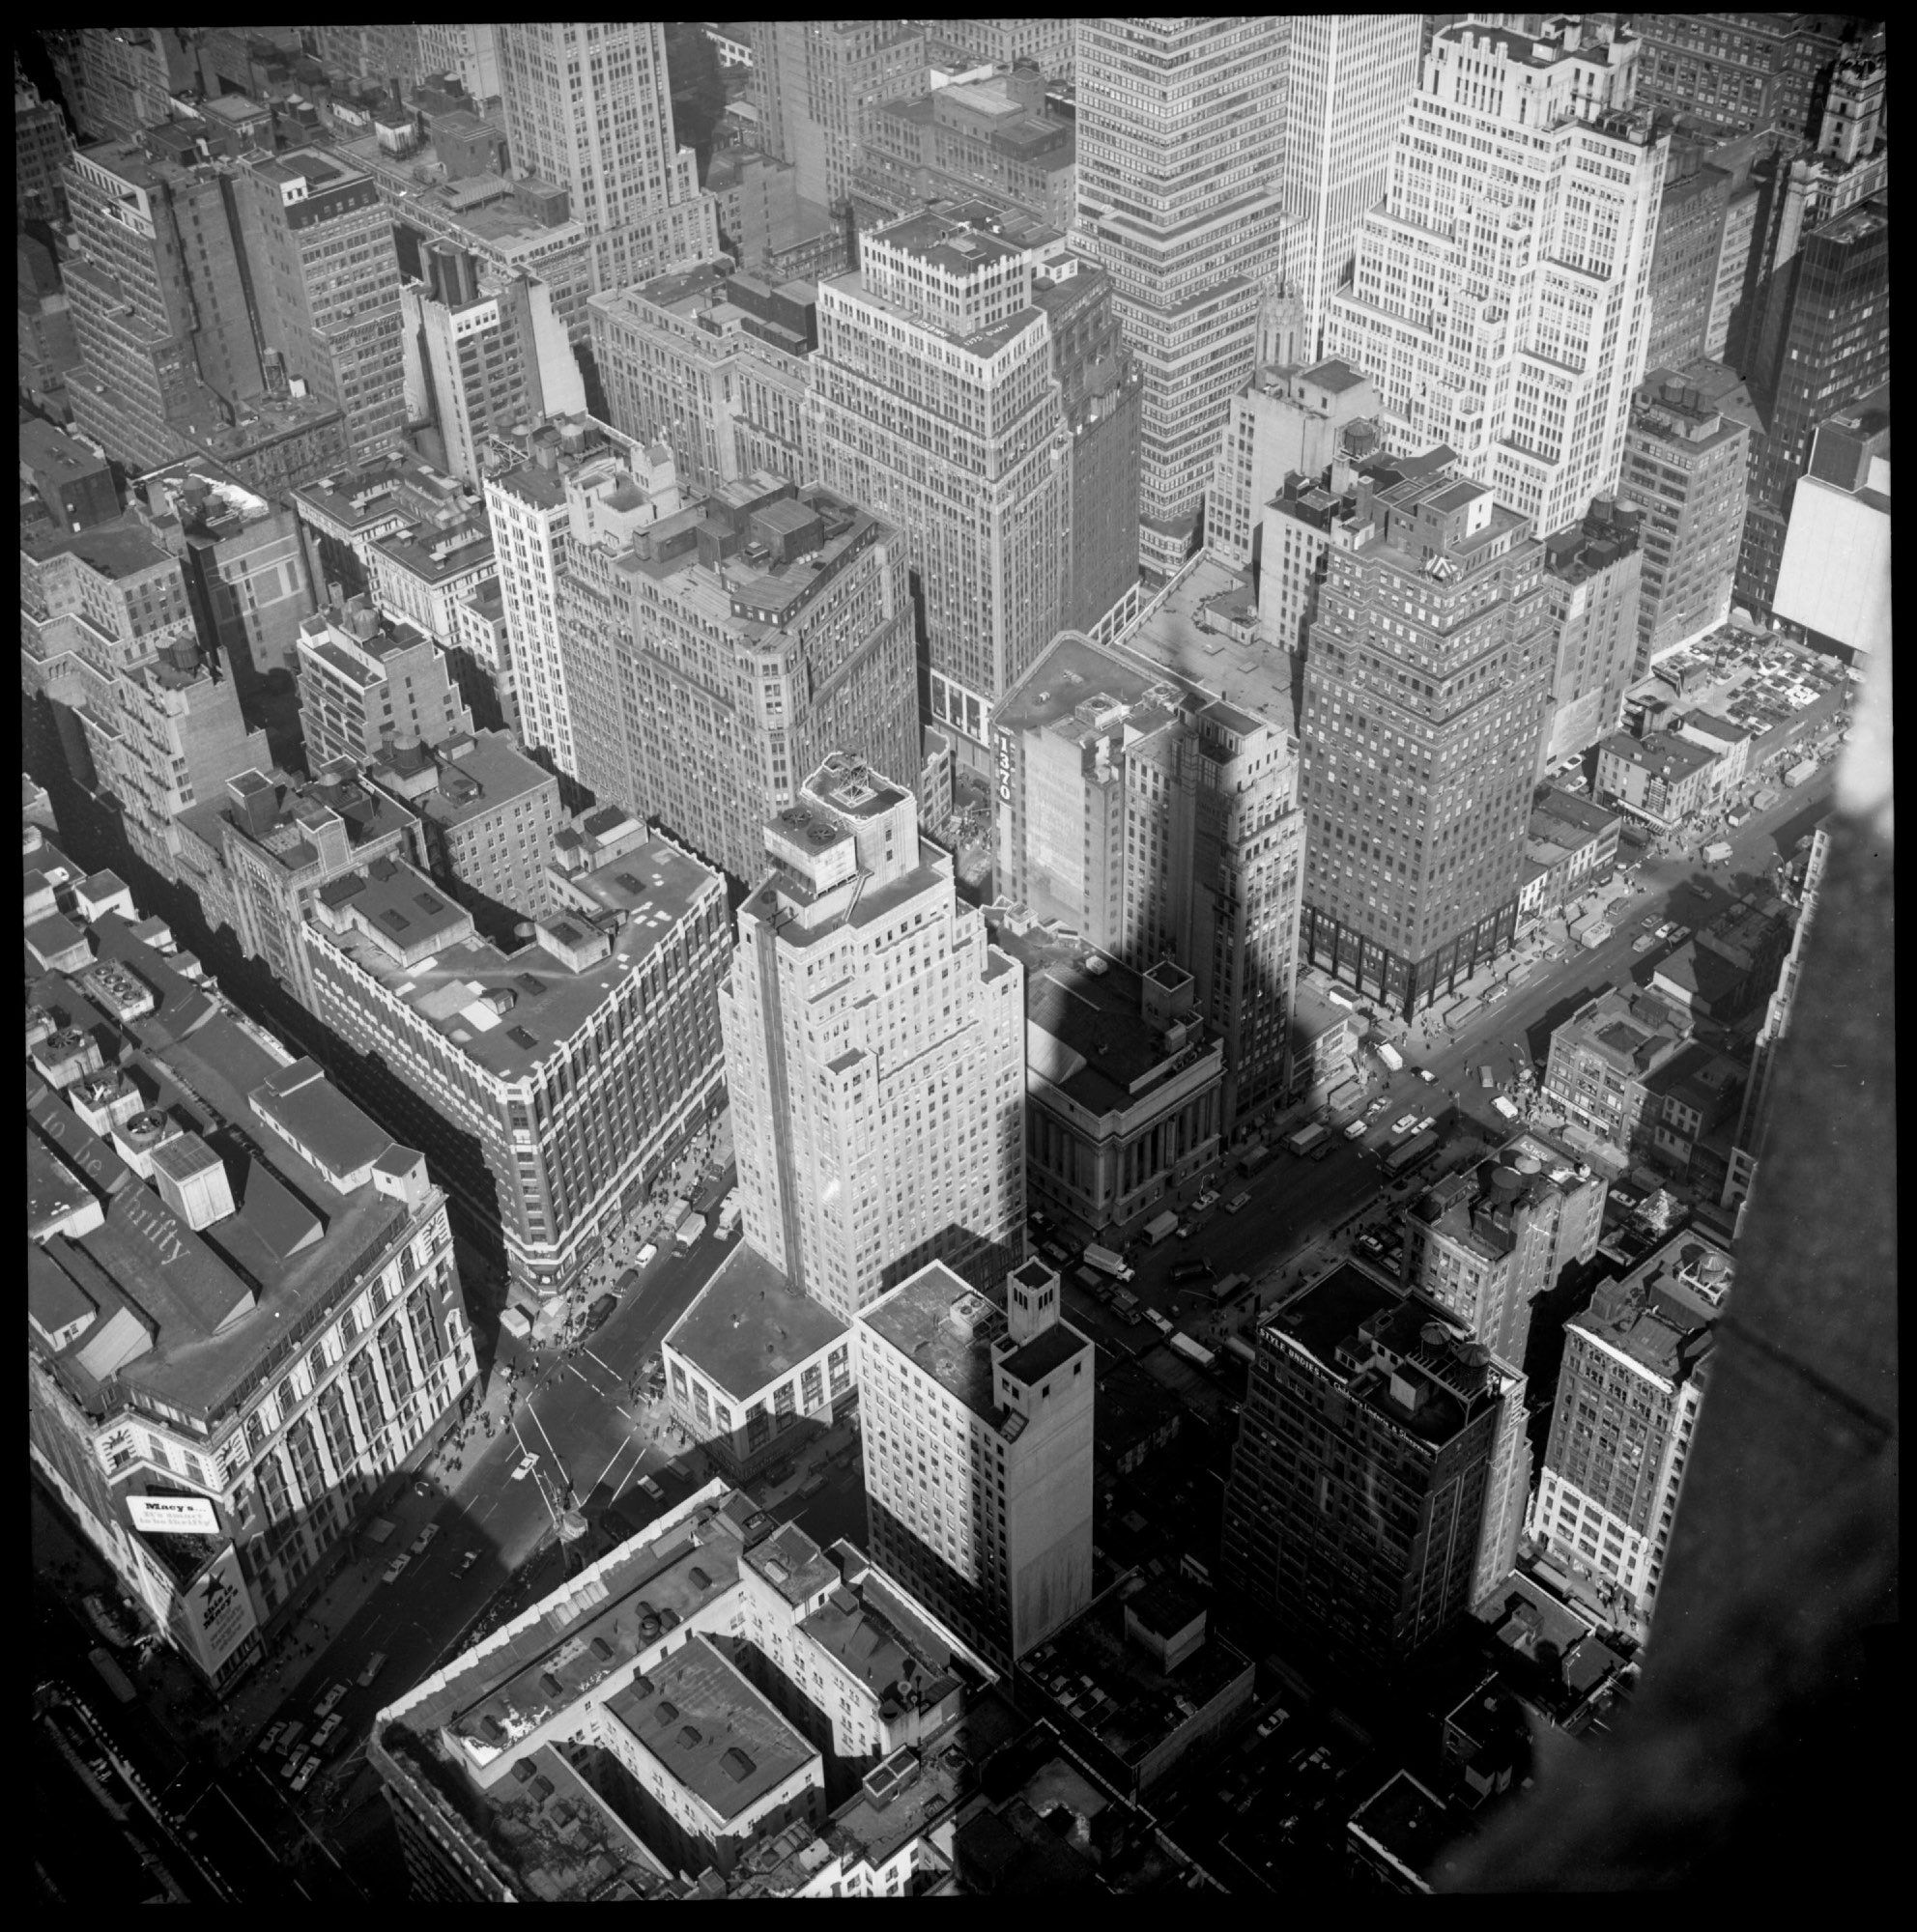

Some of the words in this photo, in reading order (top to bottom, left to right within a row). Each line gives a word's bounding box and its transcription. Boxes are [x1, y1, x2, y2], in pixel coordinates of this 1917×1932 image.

[1000, 737, 1011, 800] 1370
[42, 1112, 66, 1139] to
[73, 1137, 102, 1178] be
[115, 1183, 191, 1265] thrifty
[1259, 1327, 1287, 1353] STYLE
[1288, 1349, 1321, 1377] UNDIES
